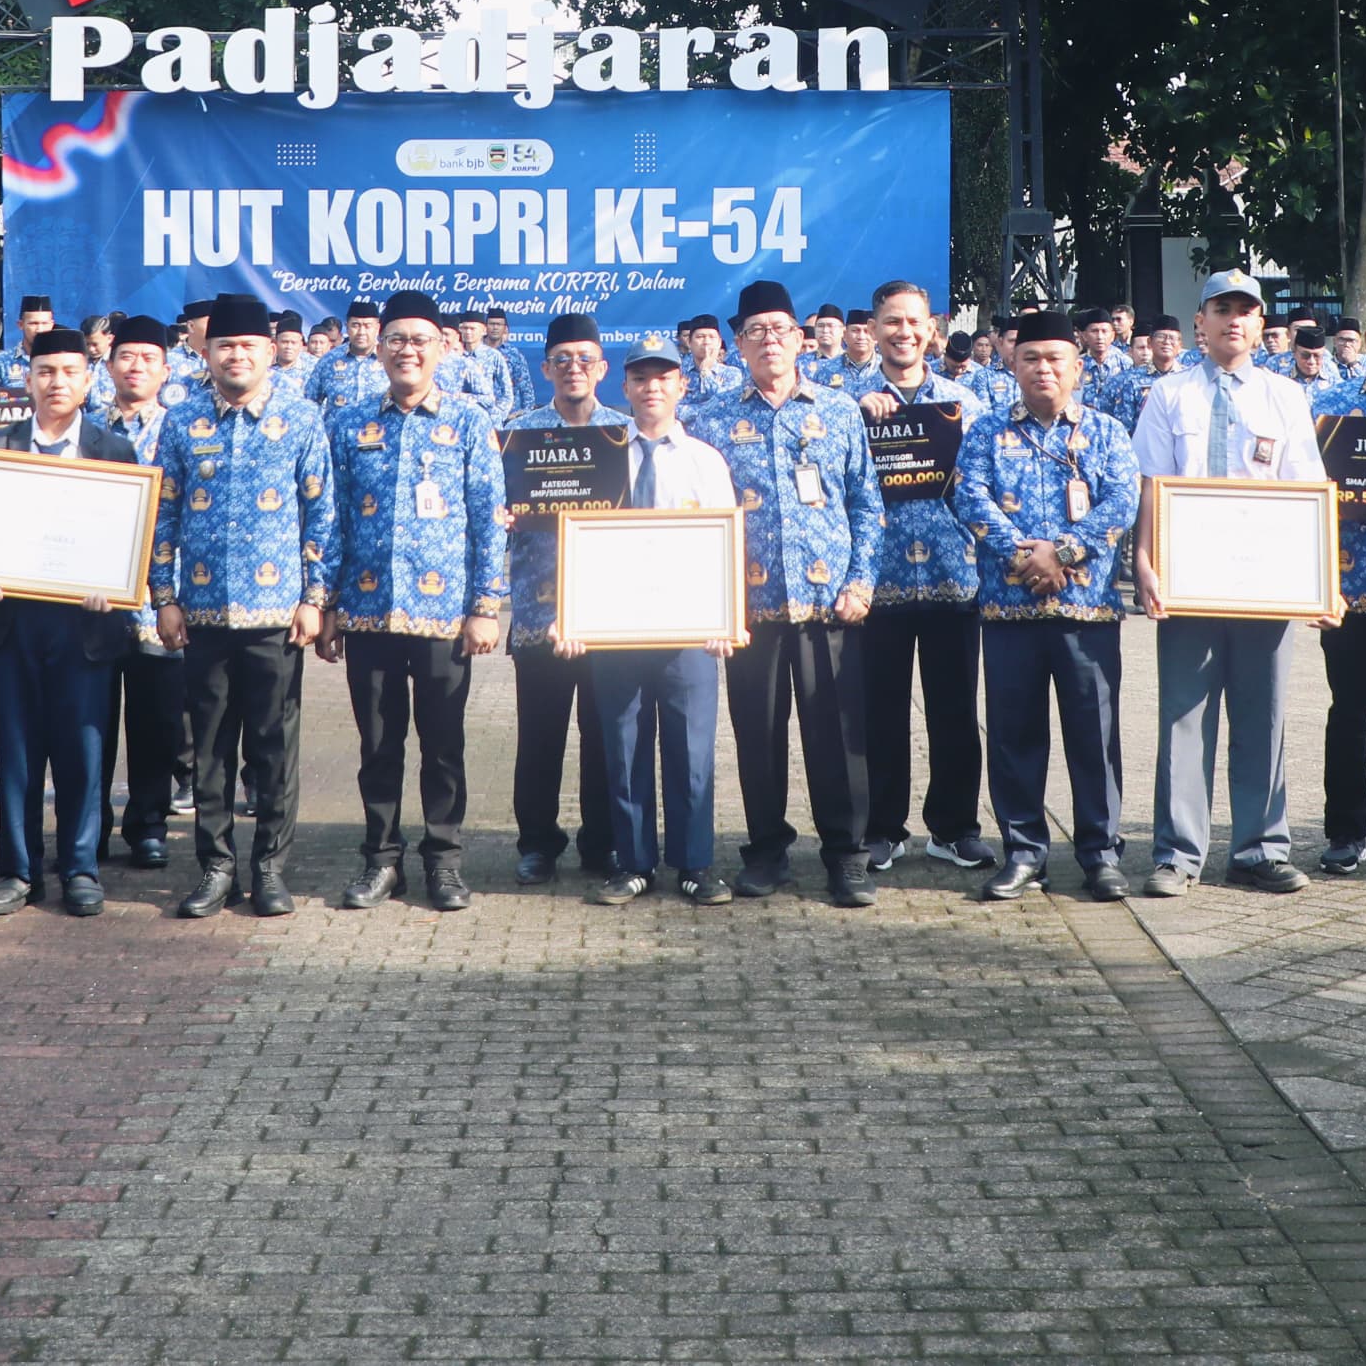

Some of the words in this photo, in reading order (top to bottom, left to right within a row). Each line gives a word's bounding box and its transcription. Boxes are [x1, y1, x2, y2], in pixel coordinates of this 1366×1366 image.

[50, 1, 890, 110] Padjadjaran
[439, 158, 464, 169] bank
[466, 158, 485, 170] bjb
[142, 189, 284, 266] HUT
[308, 188, 568, 266] KORPRI
[593, 186, 808, 265] KE-54
[357, 270, 447, 293] Berdaulat,
[453, 272, 530, 291] Bersama
[534, 270, 620, 294] KORPRI,
[626, 269, 685, 291] Dalam
[466, 293, 545, 315] Indonesia
[599, 330, 641, 342] mber
[866, 423, 913, 439] UARA
[917, 422, 925, 435] 1
[526, 447, 579, 464] JUARA
[582, 447, 592, 461] 3
[875, 453, 914, 463] KATEGORI
[541, 479, 580, 489] KATEGORI
[530, 487, 592, 498] SMP/SEDERAJAT
[1337, 490, 1359, 503] RP.
[511, 502, 534, 515] RP.
